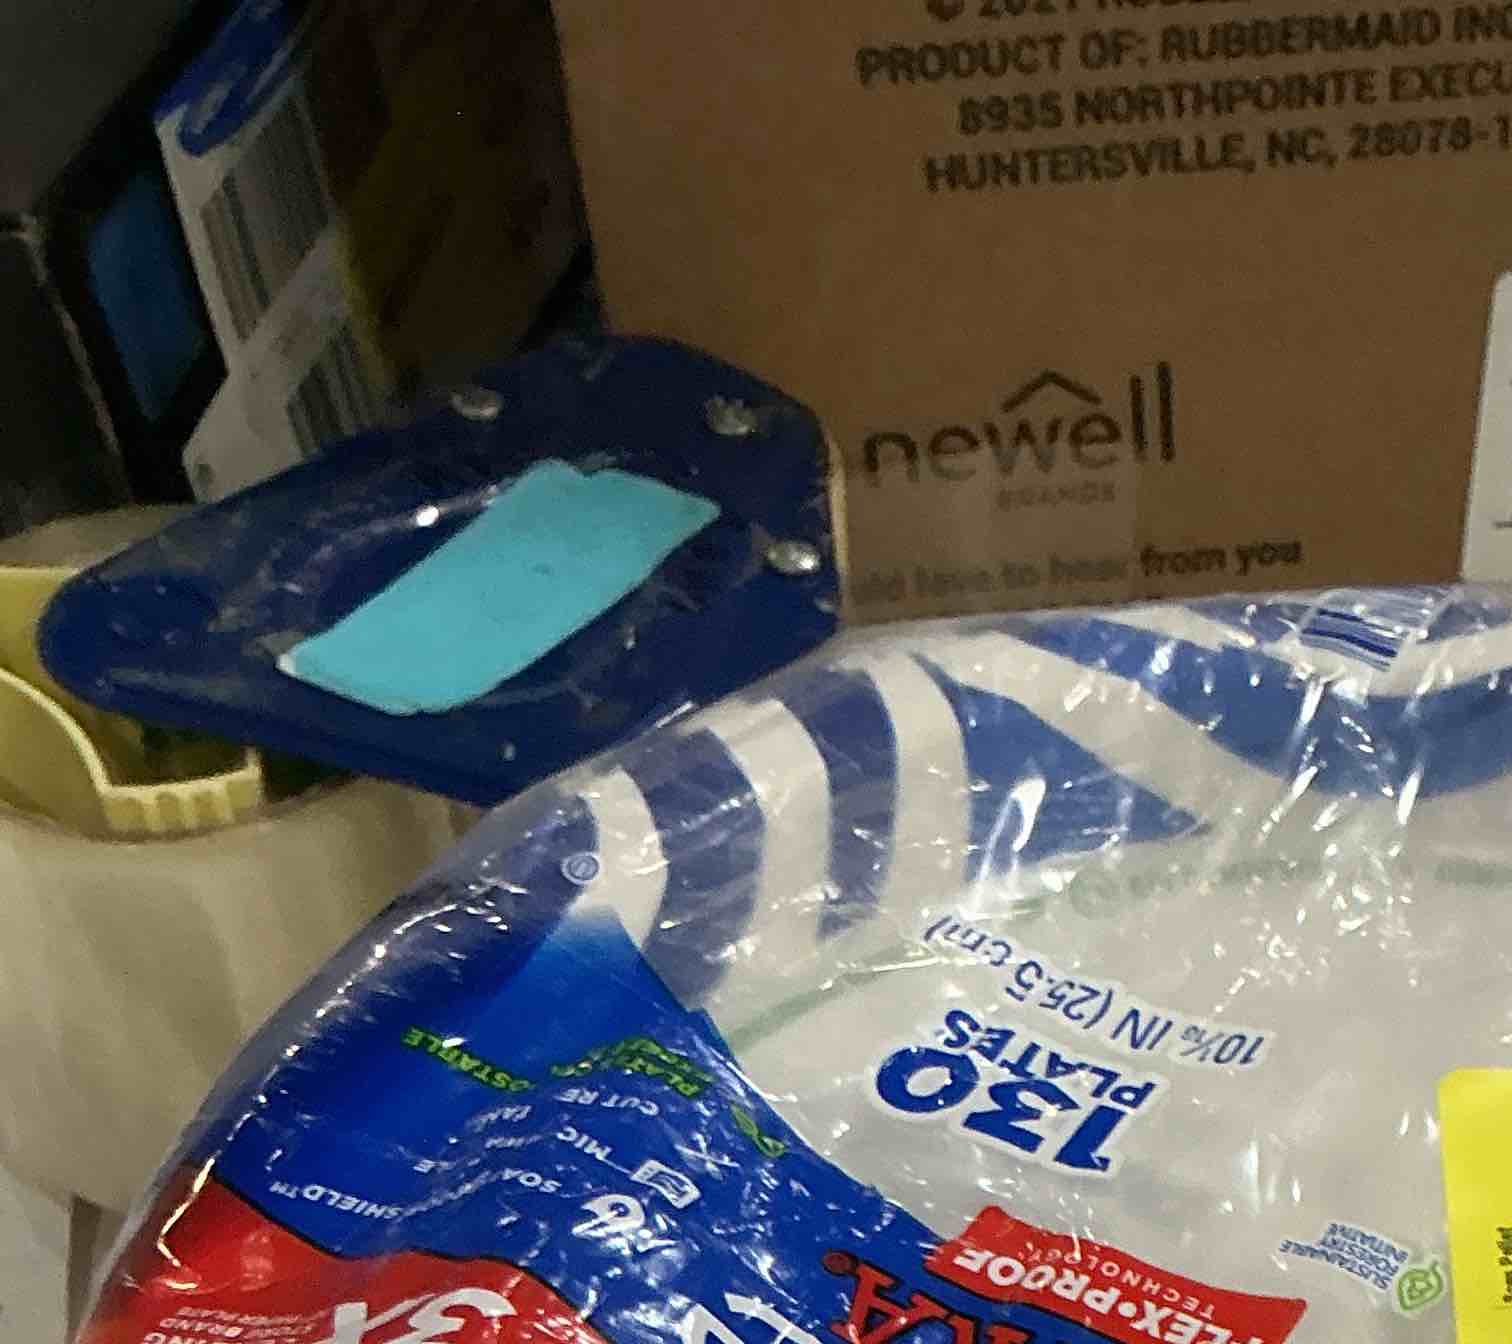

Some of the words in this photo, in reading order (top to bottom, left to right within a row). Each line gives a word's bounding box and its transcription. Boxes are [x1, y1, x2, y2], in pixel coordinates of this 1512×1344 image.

[855, 33, 1066, 85] PRODUCT
[1078, 28, 1150, 71] OF:
[1159, 8, 1441, 65] RUBBERMAID
[959, 95, 1065, 136] 8935
[1074, 66, 1377, 128] NORTHPOINTE
[924, 132, 1256, 193] HUNTERSVILLE,
[1265, 126, 1338, 169] NC,
[862, 360, 1176, 488] newell
[1139, 542, 1227, 576] from
[1236, 540, 1303, 576] you
[940, 1008, 1156, 1110] PLATES
[1109, 1006, 1174, 1050] IN
[876, 1043, 1128, 1173] 130
